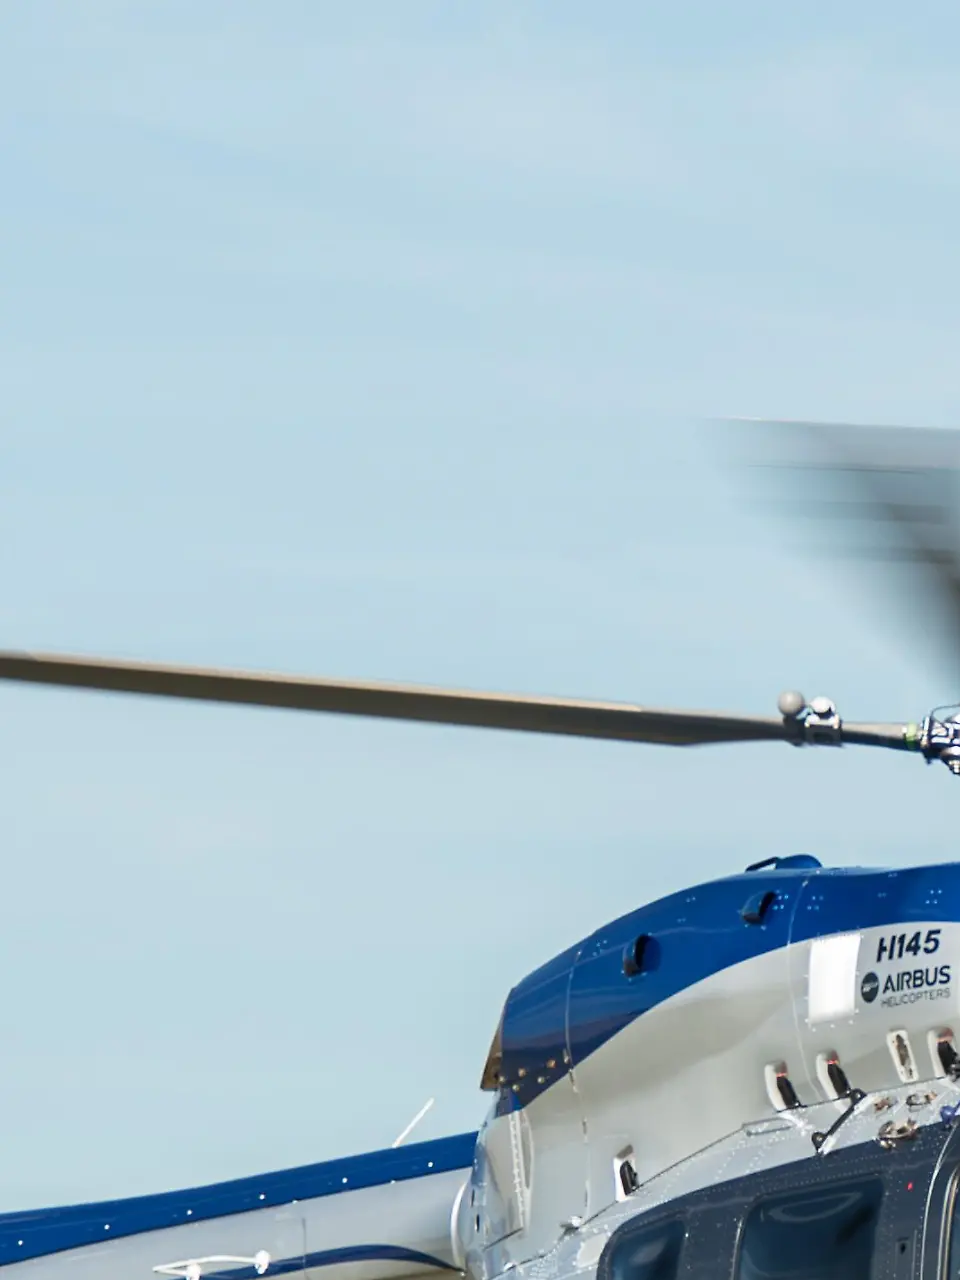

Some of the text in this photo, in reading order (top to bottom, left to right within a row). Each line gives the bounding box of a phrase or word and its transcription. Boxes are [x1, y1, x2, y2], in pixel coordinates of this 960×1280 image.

[876, 928, 942, 963] H145
[882, 965, 951, 994] AIRBUS
[880, 987, 951, 1009] HELICOPTERS
